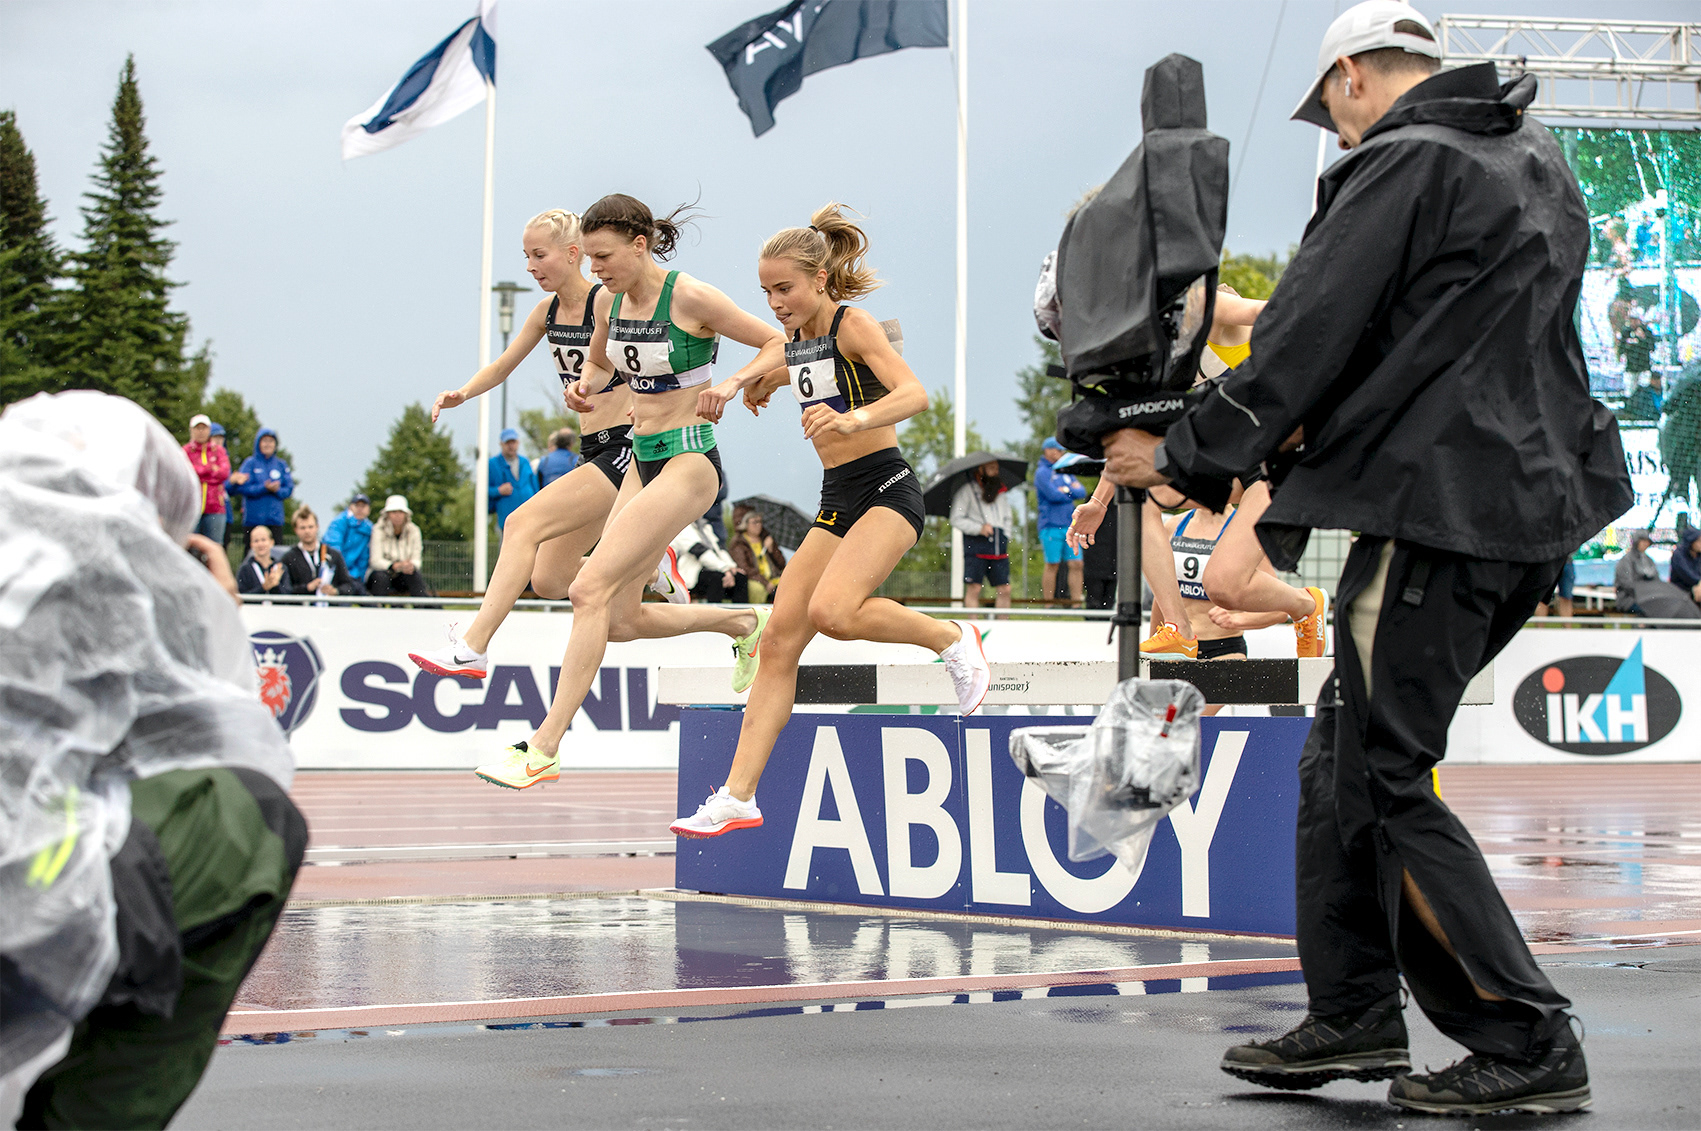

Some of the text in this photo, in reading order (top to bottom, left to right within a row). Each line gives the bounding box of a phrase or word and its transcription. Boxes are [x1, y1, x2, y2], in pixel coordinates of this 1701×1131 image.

[553, 347, 585, 374] 12
[624, 345, 641, 373] 8
[798, 366, 814, 398] 6
[1118, 398, 1185, 419] STEADICAM
[1183, 556, 1199, 579] 9
[1180, 584, 1205, 597] ABLOY
[1316, 614, 1324, 641] HOKA
[783, 726, 1250, 918] ABLOY
